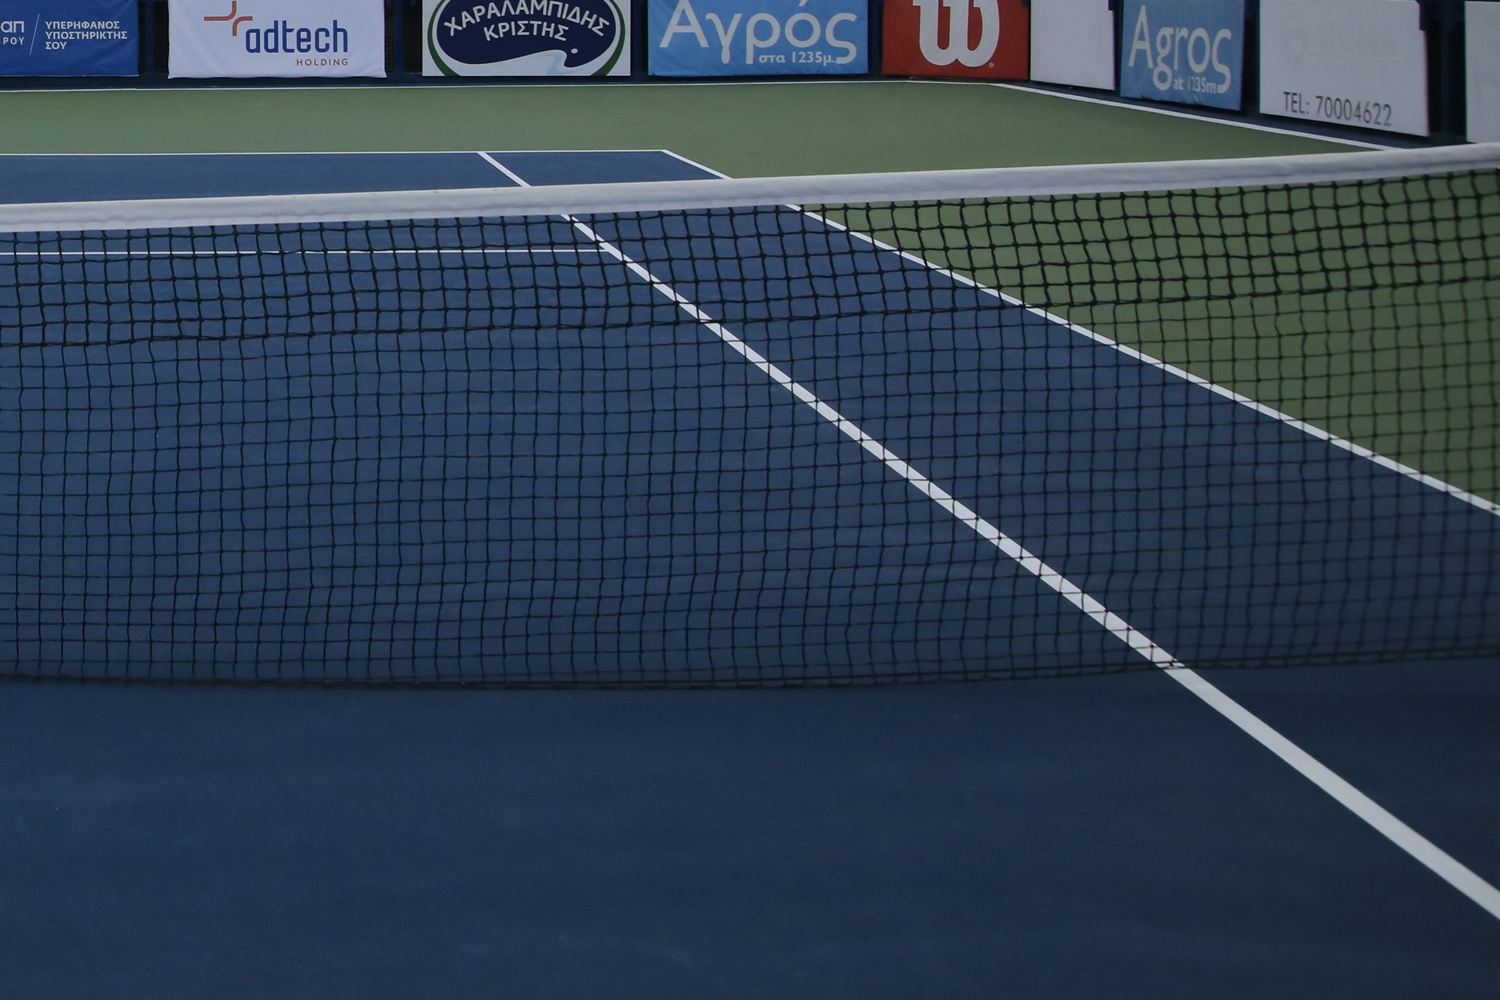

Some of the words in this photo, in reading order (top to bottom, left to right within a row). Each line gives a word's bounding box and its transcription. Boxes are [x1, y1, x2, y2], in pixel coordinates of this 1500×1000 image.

[45, 20, 120, 31] ΥΠΕΡΗΦΑΝΟΣ
[483, 20, 569, 42] ΚΡΙΣΤΗΣ
[45, 31, 128, 40] ΥΠΟΣΤΗΡΙΚΤΗΣ
[245, 19, 348, 53] adtech
[45, 41, 67, 50] ΣΟΥ
[296, 58, 349, 67] HOLDING
[758, 54, 786, 63] στα
[1173, 77, 1184, 90] at
[1283, 91, 1310, 115] TEL:
[1315, 95, 1393, 127] 70004622
